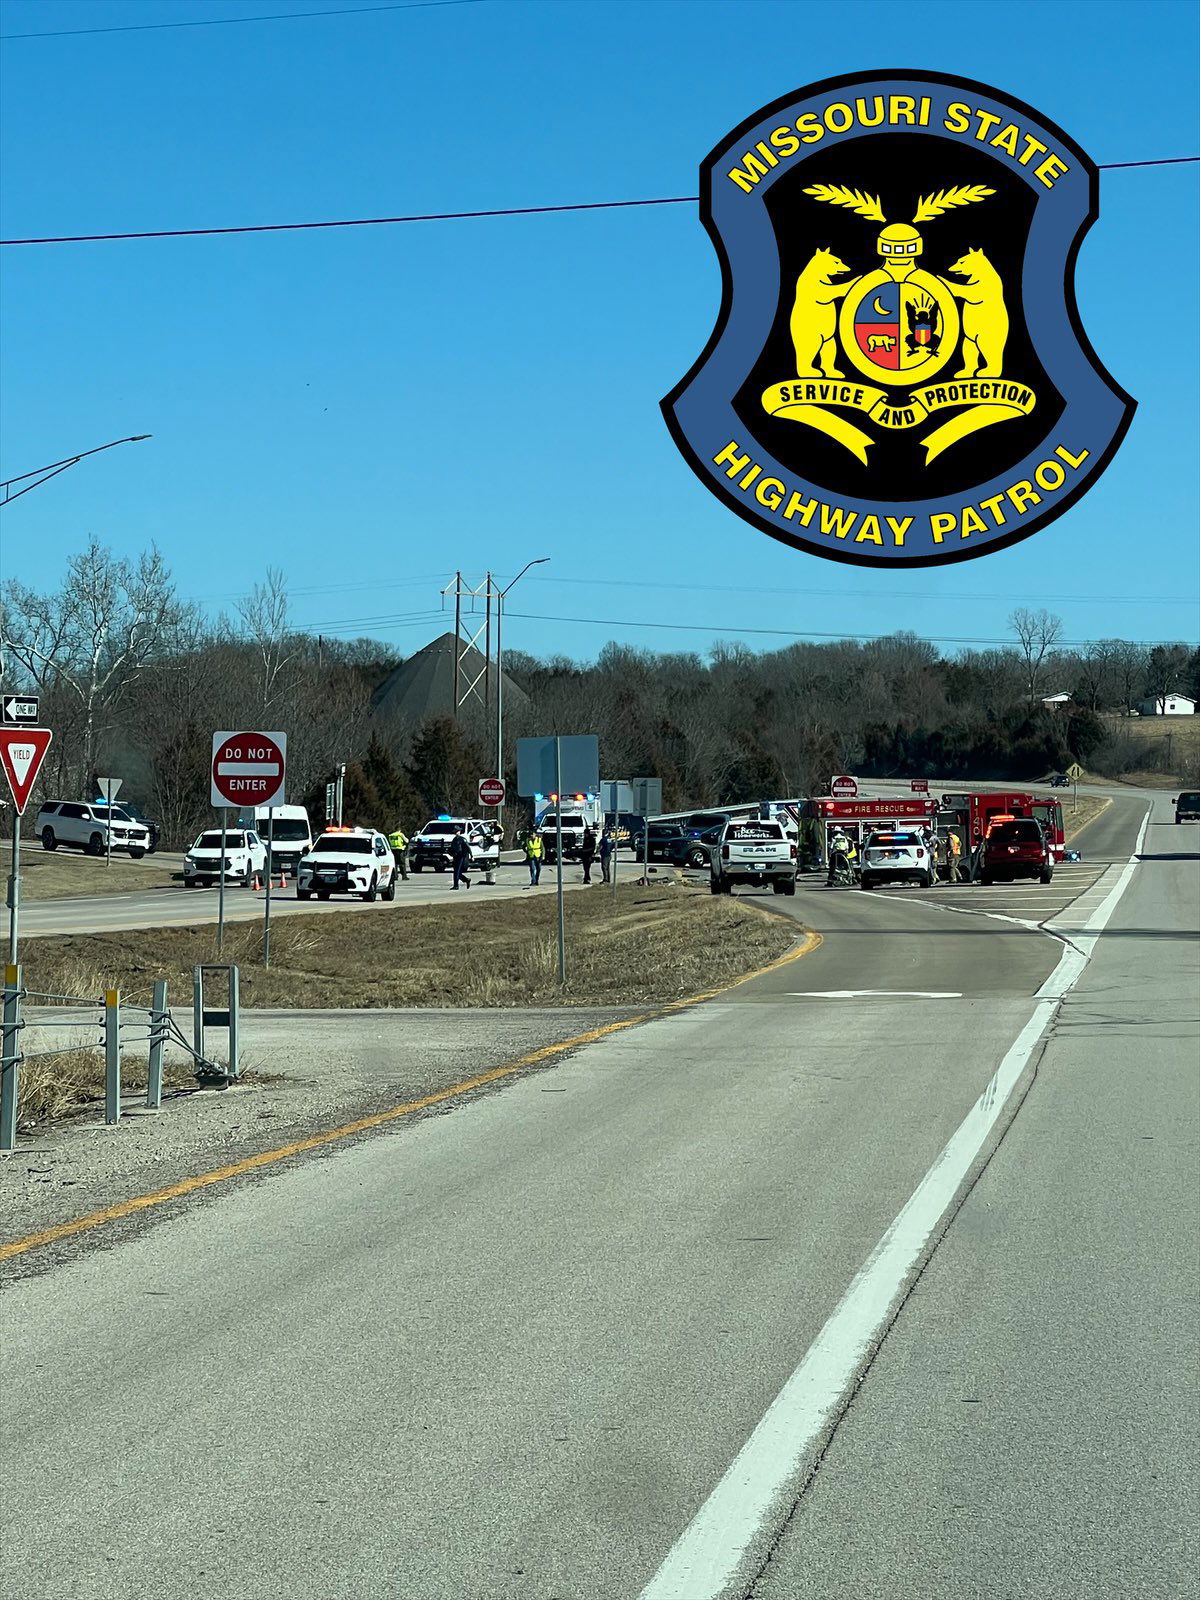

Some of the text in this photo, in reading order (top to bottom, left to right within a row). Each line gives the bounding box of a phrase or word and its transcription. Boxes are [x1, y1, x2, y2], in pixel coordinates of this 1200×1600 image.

[15, 704, 36, 715] ONE WAY
[13, 749, 31, 760] YIELD
[225, 748, 273, 759] DO NOT
[229, 780, 267, 791] ENTER
[875, 805, 905, 813] RESCUE
